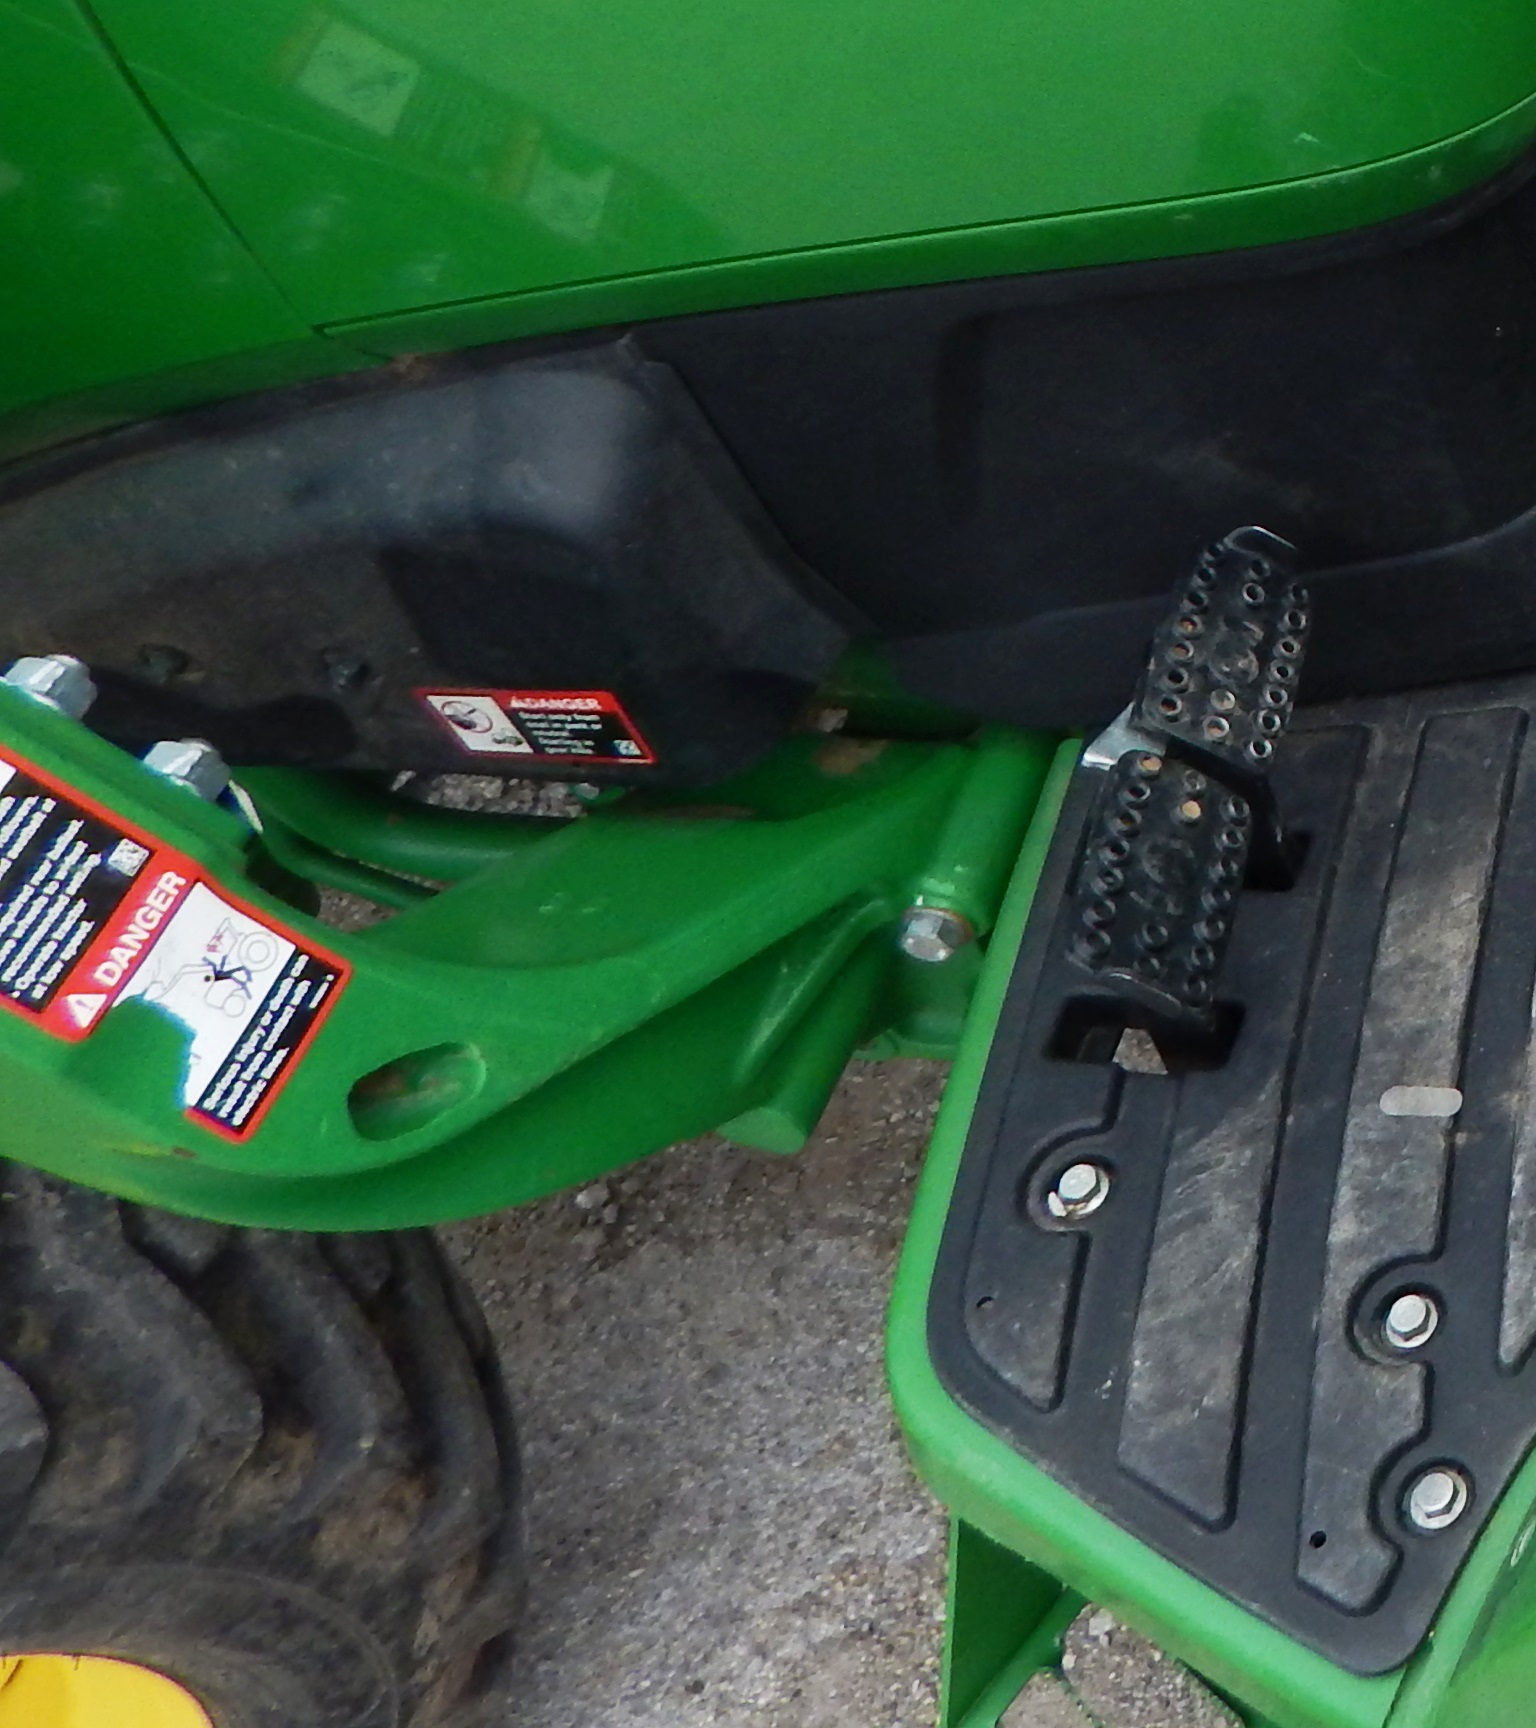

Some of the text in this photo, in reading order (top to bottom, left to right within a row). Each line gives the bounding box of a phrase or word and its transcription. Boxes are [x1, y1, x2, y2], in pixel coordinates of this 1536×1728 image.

[524, 696, 602, 711] DANGER
[12, 895, 49, 938] wheels
[43, 881, 60, 894] to
[30, 860, 52, 886] rear
[1, 894, 70, 982] recommended
[15, 898, 88, 990] Operate tractor
[31, 921, 95, 999] at low speed.
[95, 871, 186, 987] DANGER
[202, 954, 310, 1111] Serious injury or death can
[217, 979, 312, 1118] result from contact with
[232, 1078, 267, 1127] electric
